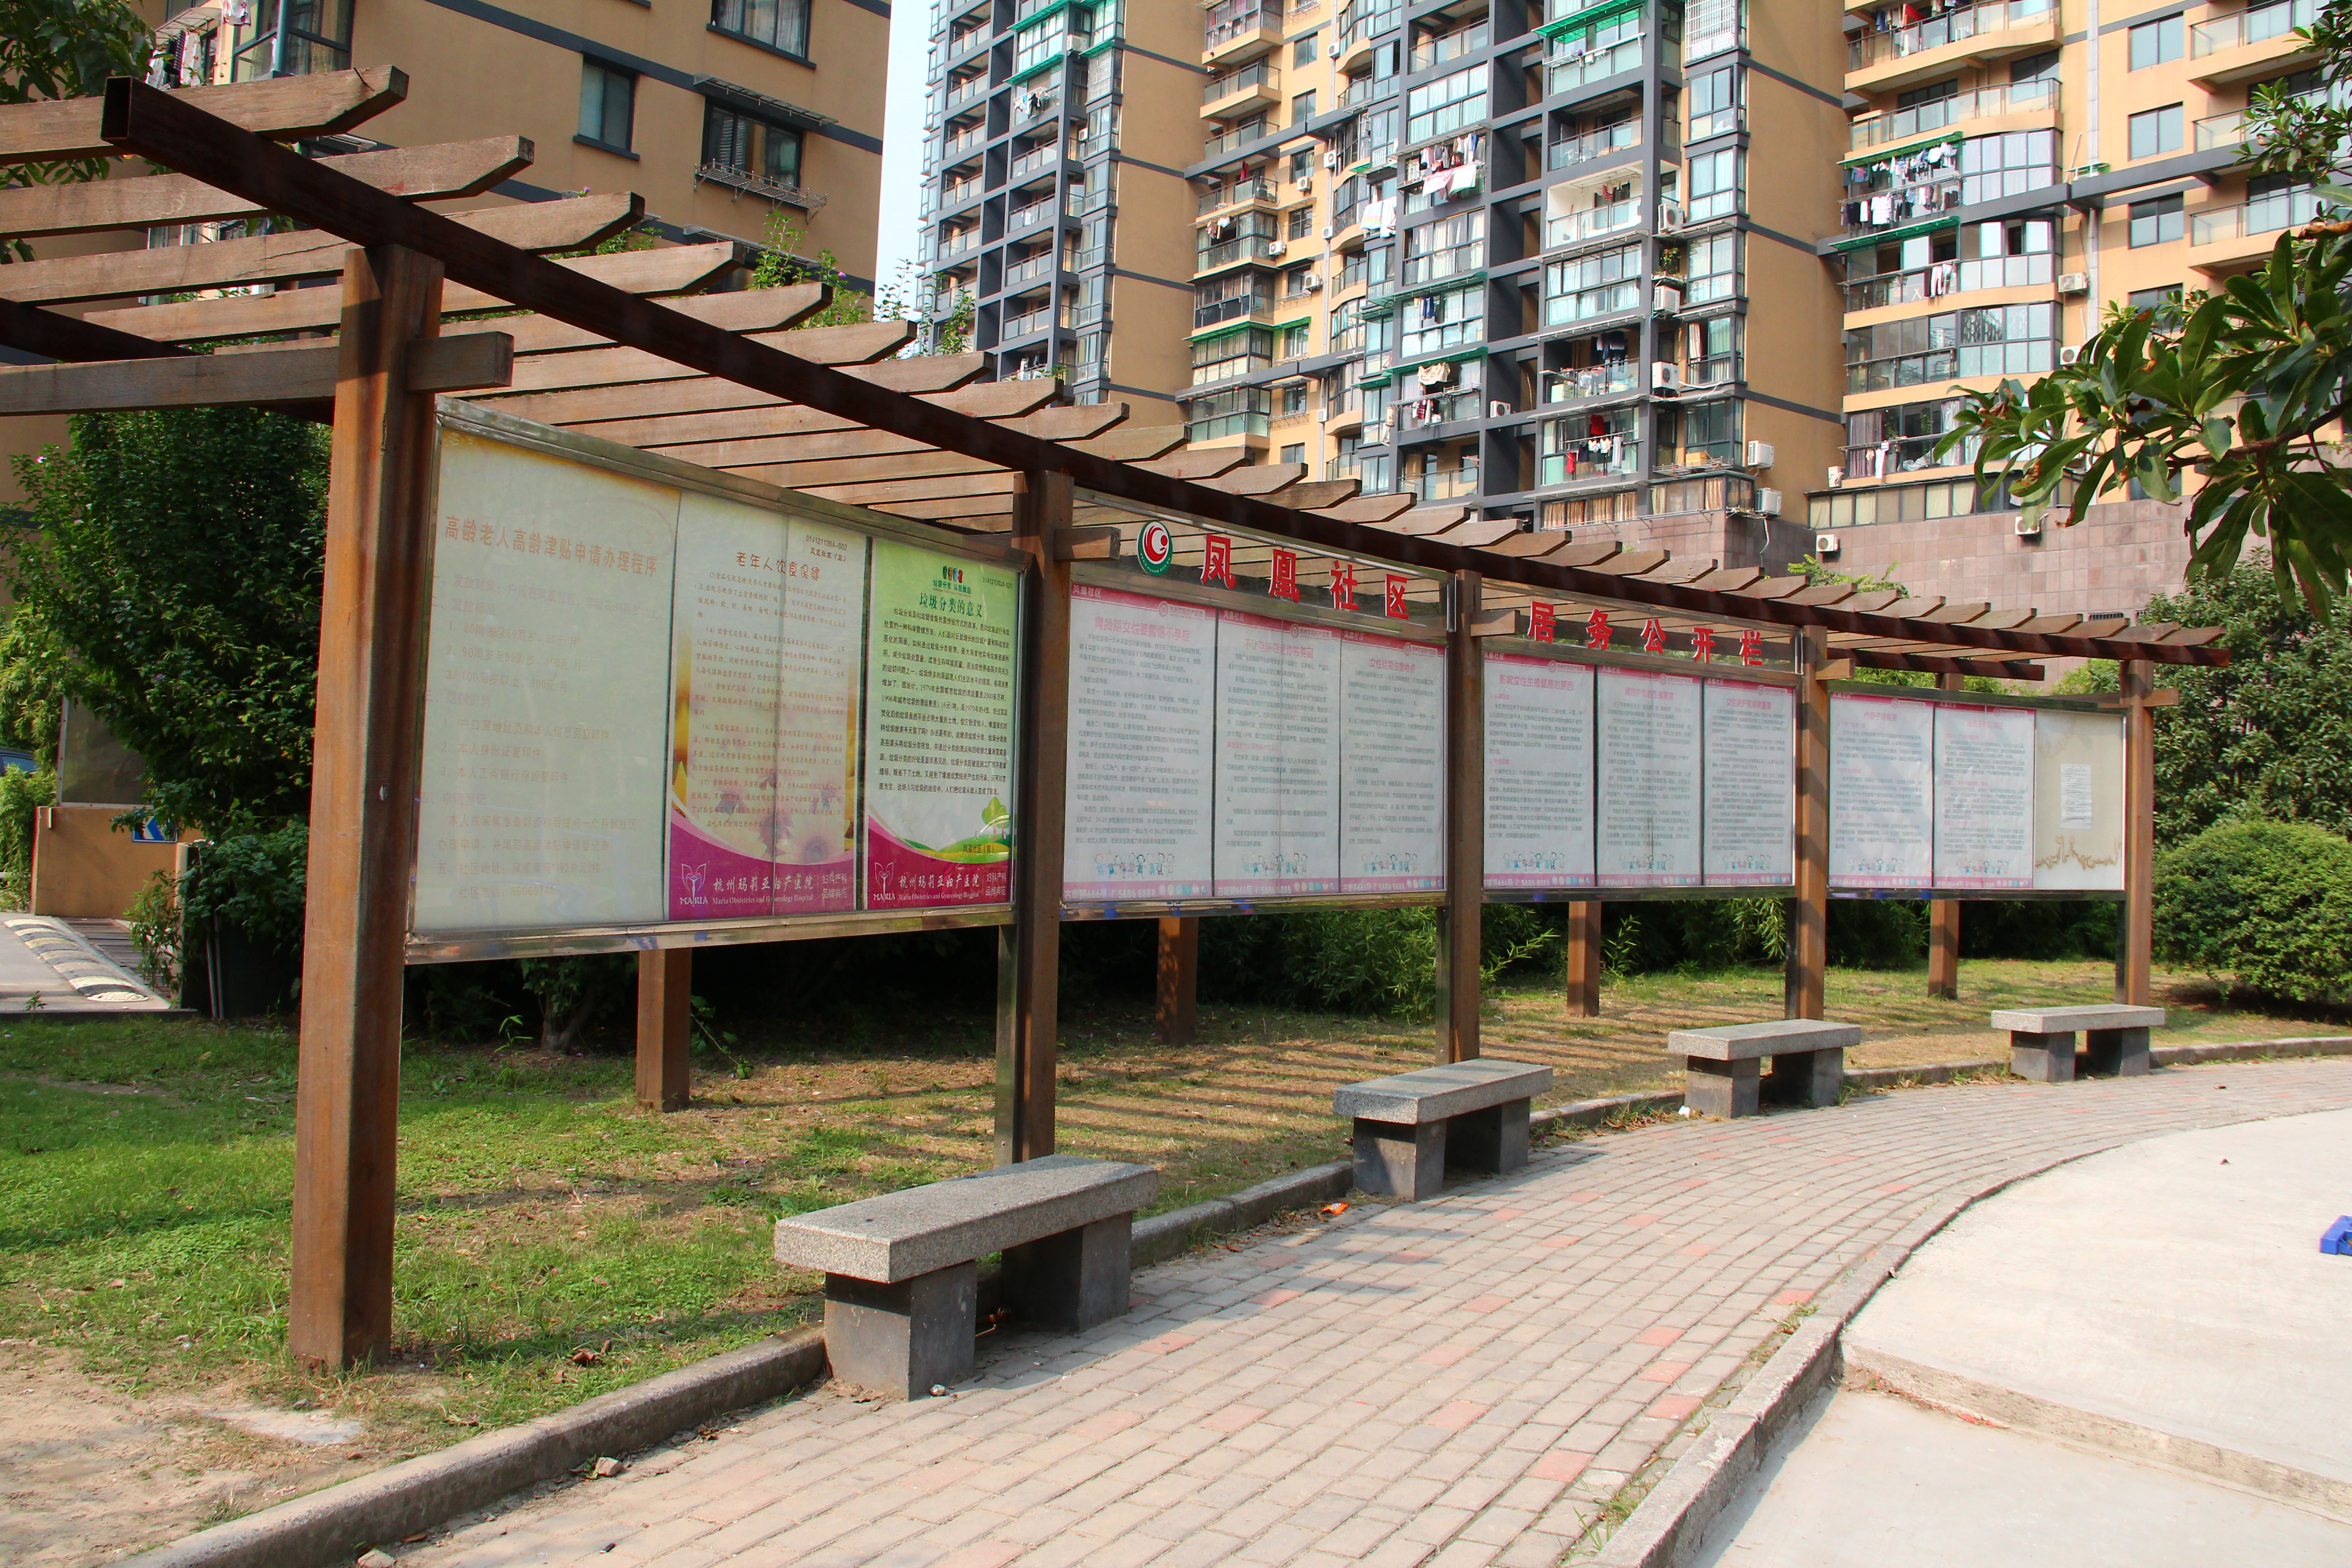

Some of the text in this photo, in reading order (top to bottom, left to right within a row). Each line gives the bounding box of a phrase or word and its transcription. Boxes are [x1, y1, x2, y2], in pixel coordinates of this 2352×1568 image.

[444, 514, 657, 578] 高龄老人高龄津贴申请办理程序
[806, 534, 847, 551] 014121120A-002
[736, 549, 820, 583] 老年人饮食保健
[1200, 534, 1409, 620] 凤凰社区
[1073, 584, 1101, 598] 凤凰社区
[919, 591, 982, 618] 垃圾分类的意义
[1527, 600, 1764, 667] 居务公开栏
[899, 873, 980, 890] 杭州玛莉亚妇产医院
[679, 896, 708, 906] MARIA
[712, 897, 729, 905] Maria
[729, 896, 755, 905] Obstetrics
[794, 893, 813, 903] Hospital
[873, 892, 895, 902] MARIA
[1117, 888, 1136, 898] 5686
[1138, 888, 1156, 897] 8888
